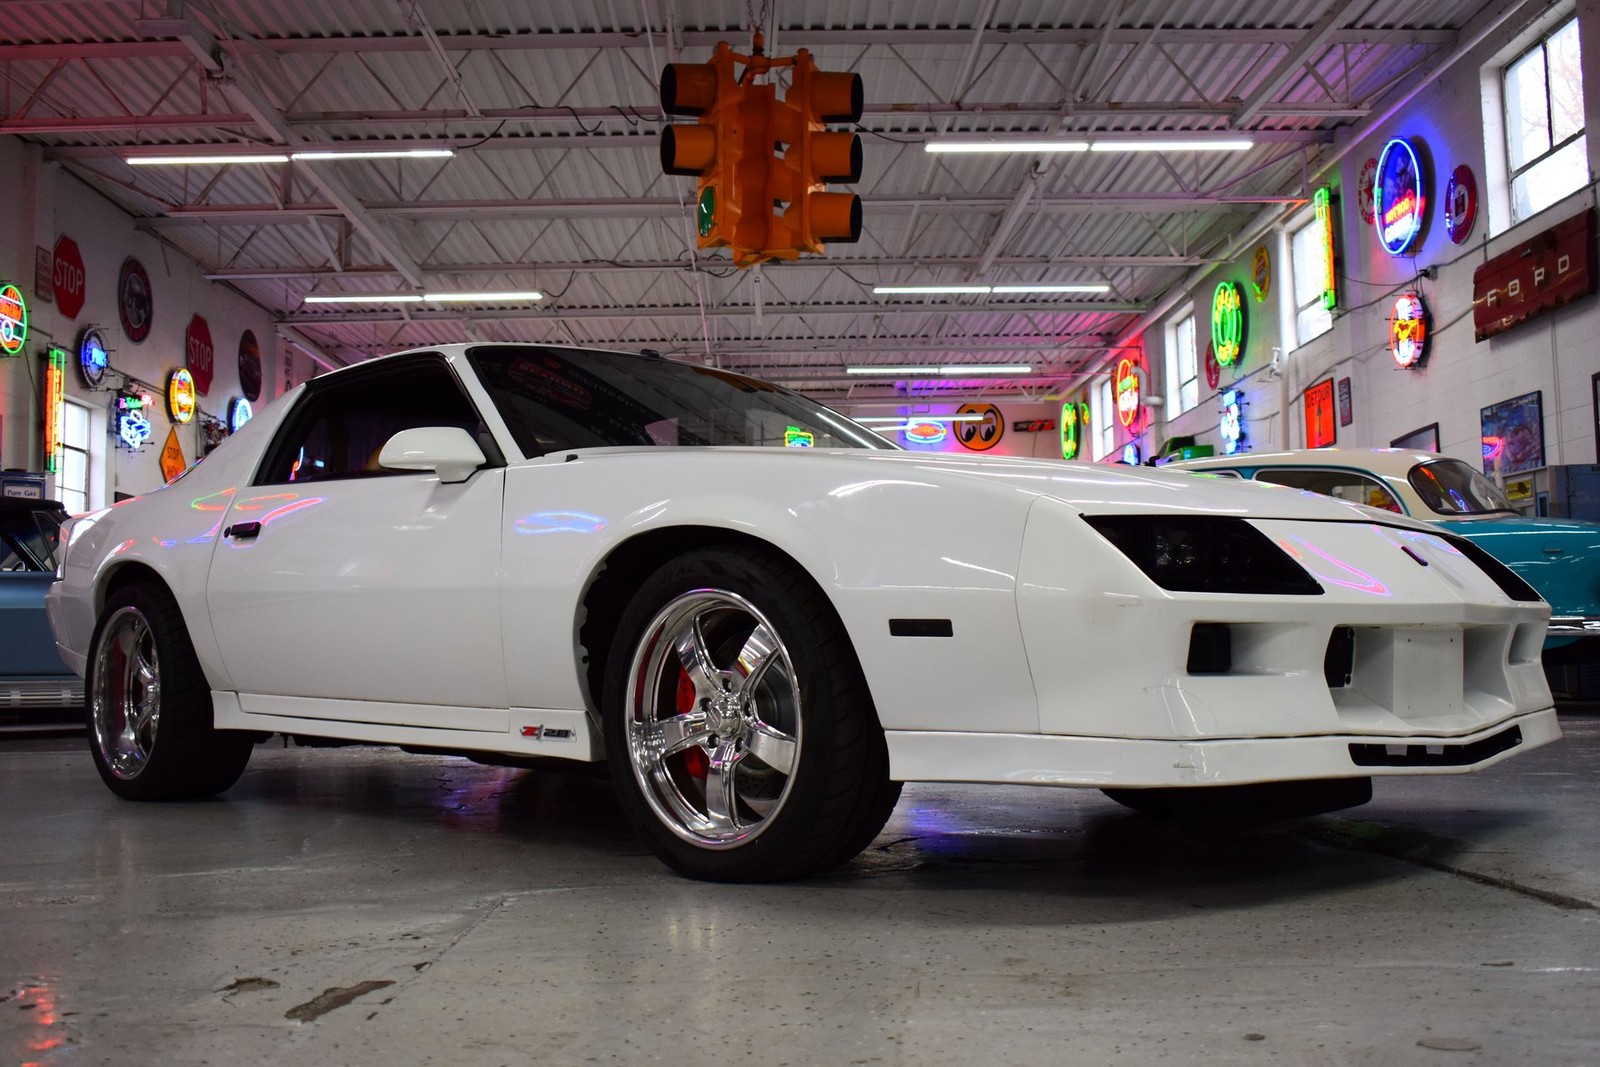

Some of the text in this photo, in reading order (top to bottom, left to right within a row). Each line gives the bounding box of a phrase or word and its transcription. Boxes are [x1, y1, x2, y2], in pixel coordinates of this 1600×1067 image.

[54, 257, 83, 296] STOP
[1487, 255, 1570, 307] FORD
[189, 336, 212, 373] STOP
[7, 489, 37, 497] Pure Gas
